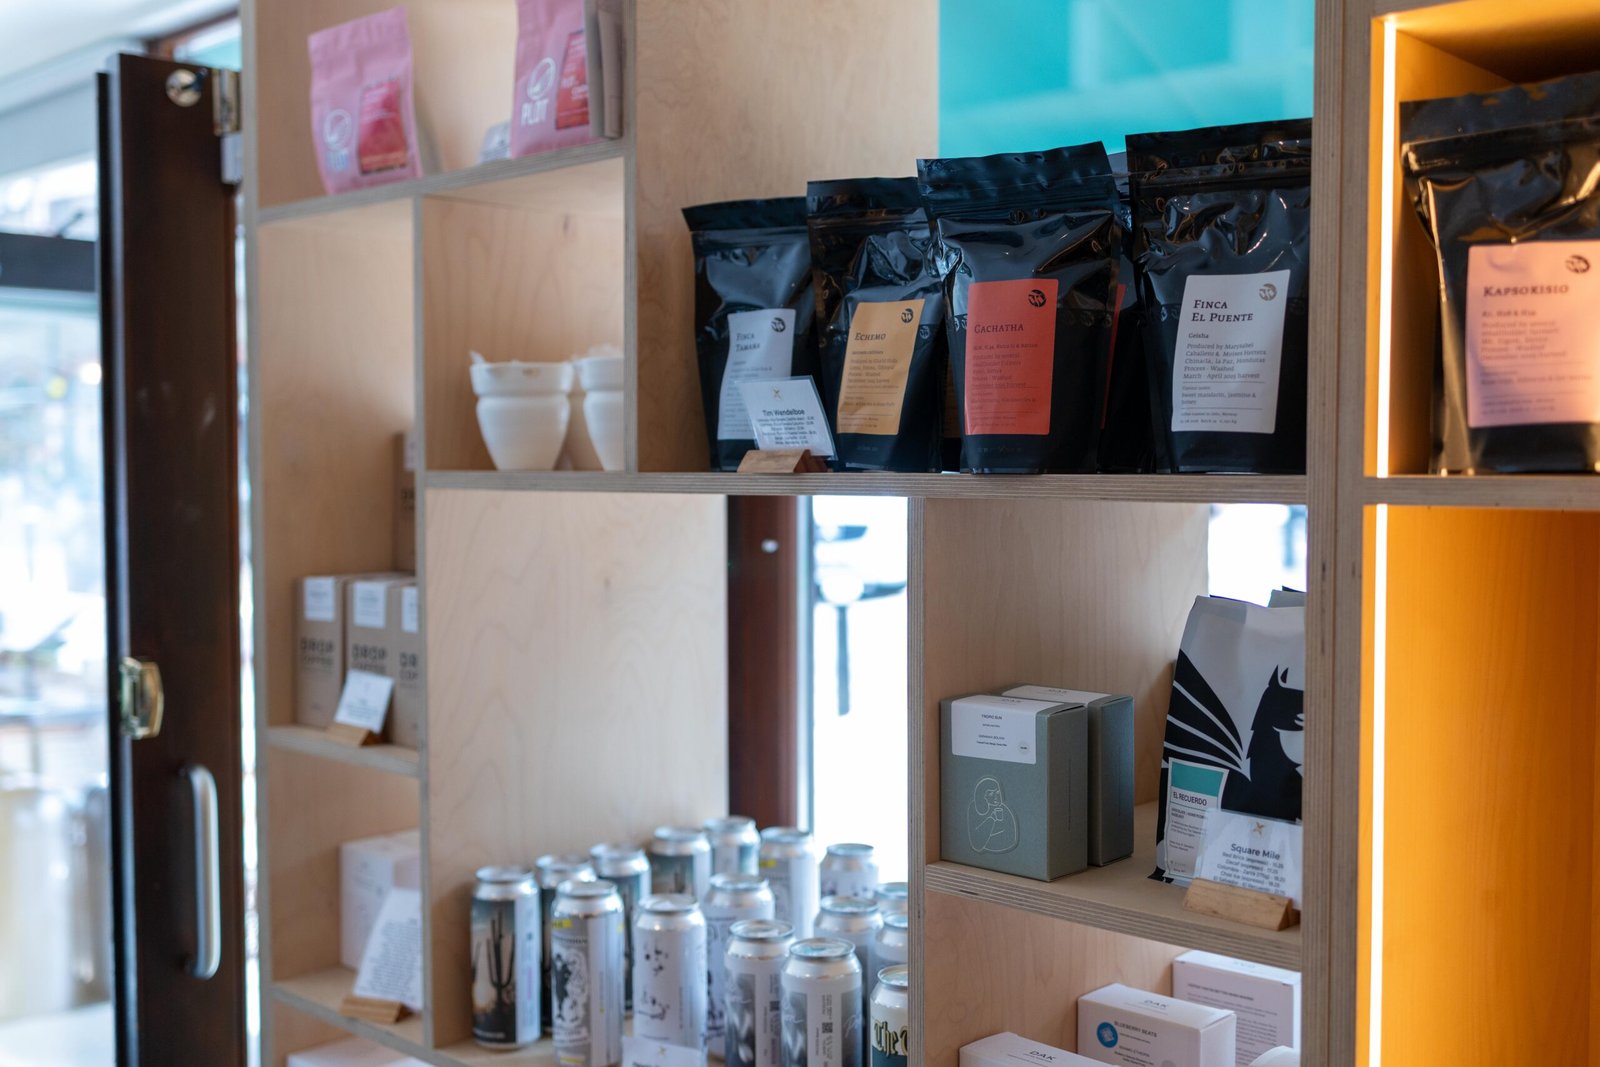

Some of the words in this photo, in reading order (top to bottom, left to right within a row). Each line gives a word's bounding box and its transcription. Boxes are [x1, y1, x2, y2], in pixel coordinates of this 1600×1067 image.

[1484, 284, 1569, 297] KAPSOKISIO
[1194, 300, 1228, 309] FINCA
[1192, 312, 1206, 322] EL
[1209, 313, 1254, 322] PUENTE
[974, 324, 1024, 334] GACHATHA
[1179, 793, 1208, 806] RECUERDO
[1230, 843, 1260, 856] Square
[1262, 850, 1280, 860] Mile
[874, 1019, 899, 1058] The
[1029, 1050, 1056, 1060] DAK
